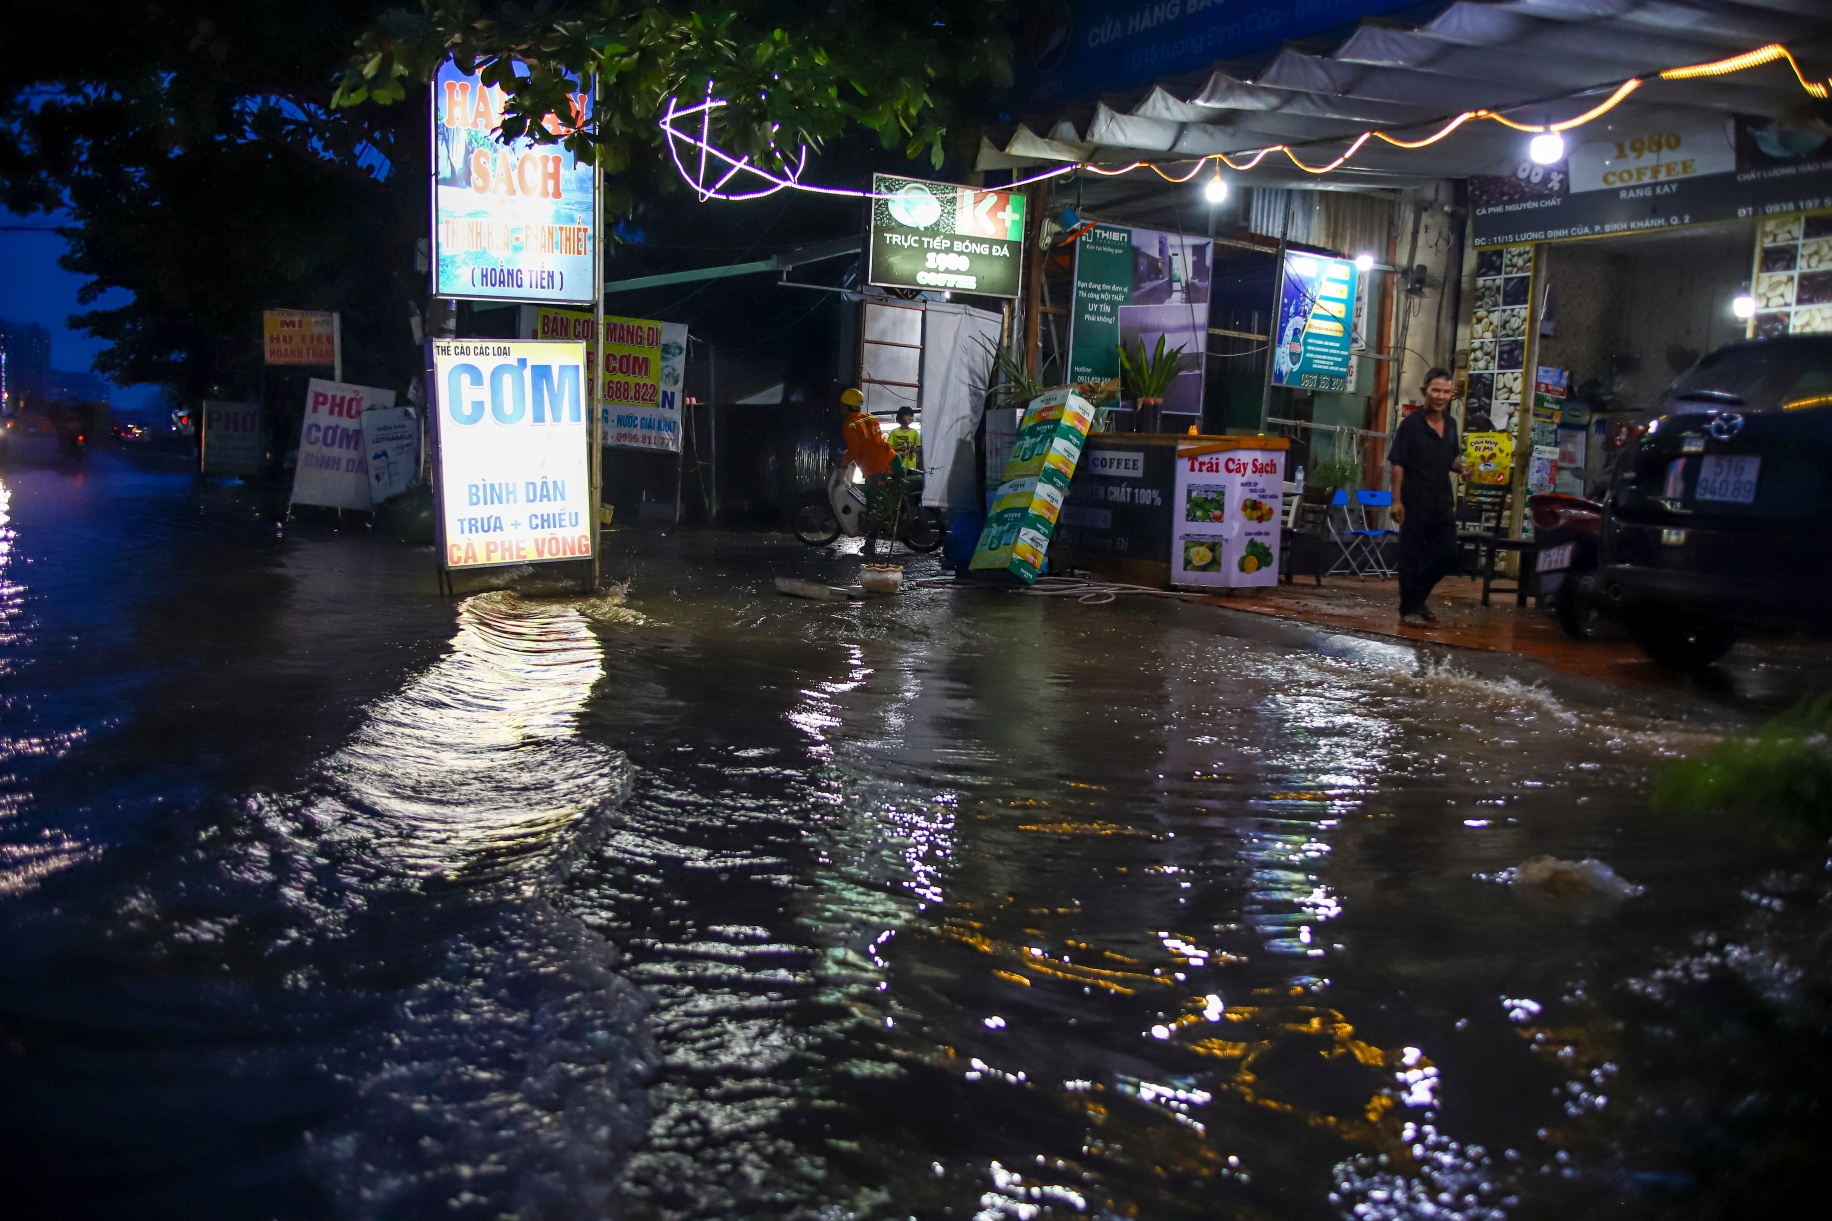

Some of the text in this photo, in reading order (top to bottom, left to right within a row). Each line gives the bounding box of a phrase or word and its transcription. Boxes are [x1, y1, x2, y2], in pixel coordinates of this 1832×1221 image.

[1614, 132, 1681, 160] 1980
[1602, 159, 1697, 186] COFFEE
[1620, 183, 1678, 200] RANG XAY
[884, 233, 919, 249] TRỰC
[953, 240, 990, 255] BÓNG
[991, 244, 1010, 258] ĐÁ
[1088, 302, 1111, 313] UY TÍN
[606, 322, 644, 348] MANG
[647, 328, 661, 349] ĐI
[453, 343, 472, 357] CÀO
[605, 353, 651, 380] CƠM
[311, 390, 364, 420] PHỞ
[448, 358, 583, 426] CƠM
[305, 422, 363, 451] CƠM
[1092, 457, 1139, 471] COFFEE
[1187, 456, 1277, 480] Trái Cây Sạch
[467, 475, 566, 507] BÌNH DÂN
[1107, 481, 1132, 503] CHẤT
[1134, 488, 1162, 506] 100%
[457, 514, 504, 535] TRƯA
[448, 540, 479, 566] CÀ
